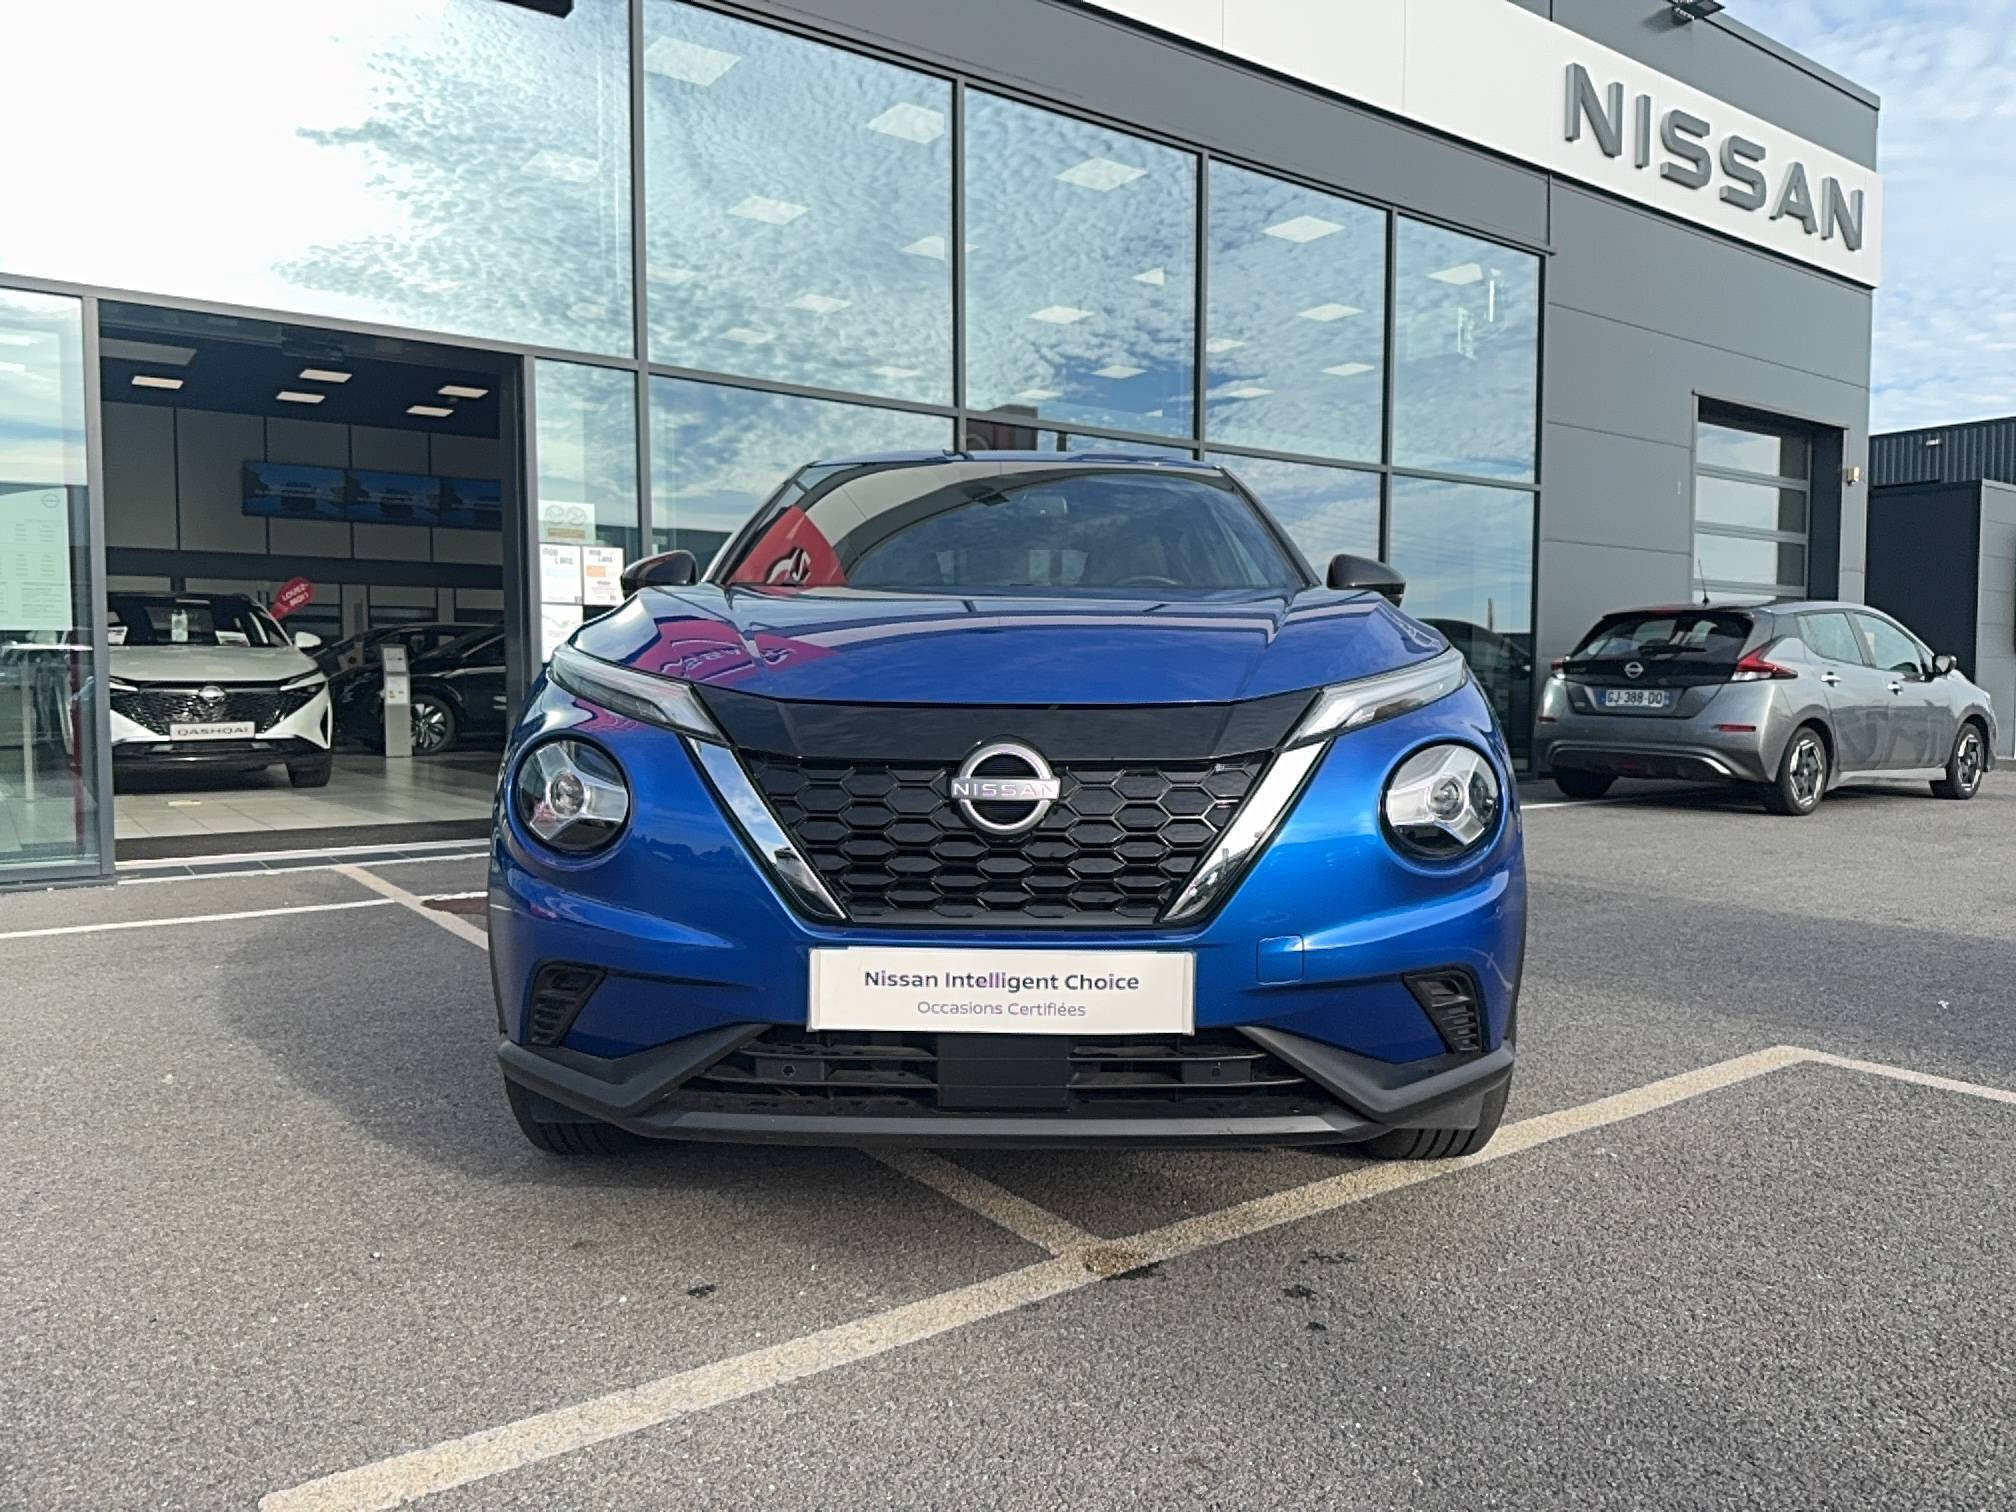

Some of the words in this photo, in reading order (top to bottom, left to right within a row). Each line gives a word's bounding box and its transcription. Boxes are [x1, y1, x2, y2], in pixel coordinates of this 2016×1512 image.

[1565, 62, 1864, 252] NISSAN
[953, 783, 1056, 797] NISSAN
[864, 971, 938, 988] Nissan
[945, 971, 1059, 993] Intelligent
[1065, 973, 1140, 990] Choice
[917, 1001, 1003, 1016] Occasions
[1008, 1001, 1086, 1017] Certifiées
